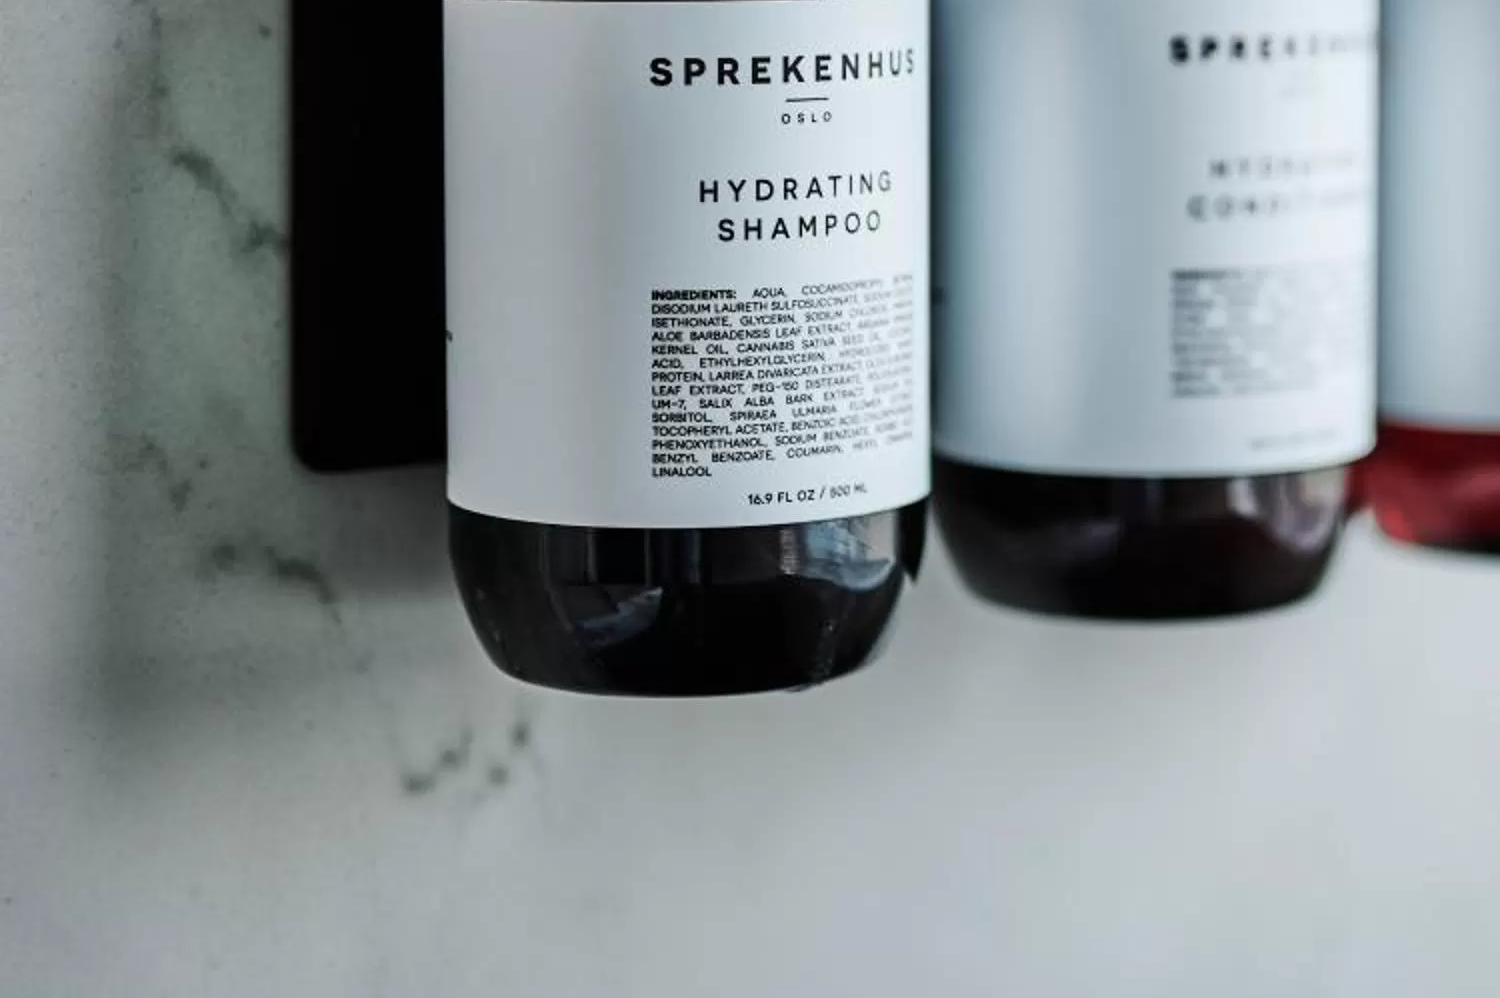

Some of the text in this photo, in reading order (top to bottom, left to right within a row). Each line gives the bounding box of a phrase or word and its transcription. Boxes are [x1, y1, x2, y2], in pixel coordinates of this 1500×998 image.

[650, 48, 914, 87] SPREKENHUS
[781, 111, 833, 125] OSLO
[699, 170, 892, 203] HYDRATING
[717, 210, 881, 242] SHAMPOO
[651, 288, 737, 301] INGREDIENTS:
[651, 303, 711, 315] DISODIUM
[714, 301, 768, 314] LAURETH
[651, 331, 684, 342] ALOE
[689, 327, 771, 341] BARBADENSIS
[651, 344, 698, 355] KERNEL
[736, 340, 795, 353] CANNABIS
[651, 385, 682, 397] LEAF
[744, 396, 775, 407] ALBA
[786, 393, 813, 404] BARK
[652, 426, 733, 437] TOCOPHERYL
[775, 433, 817, 446] SODIUM
[652, 453, 699, 464] BENZYL
[652, 466, 713, 477] LINALOOL
[747, 493, 773, 505] 16.9
[777, 491, 793, 503] FL
[797, 489, 815, 502] OZ
